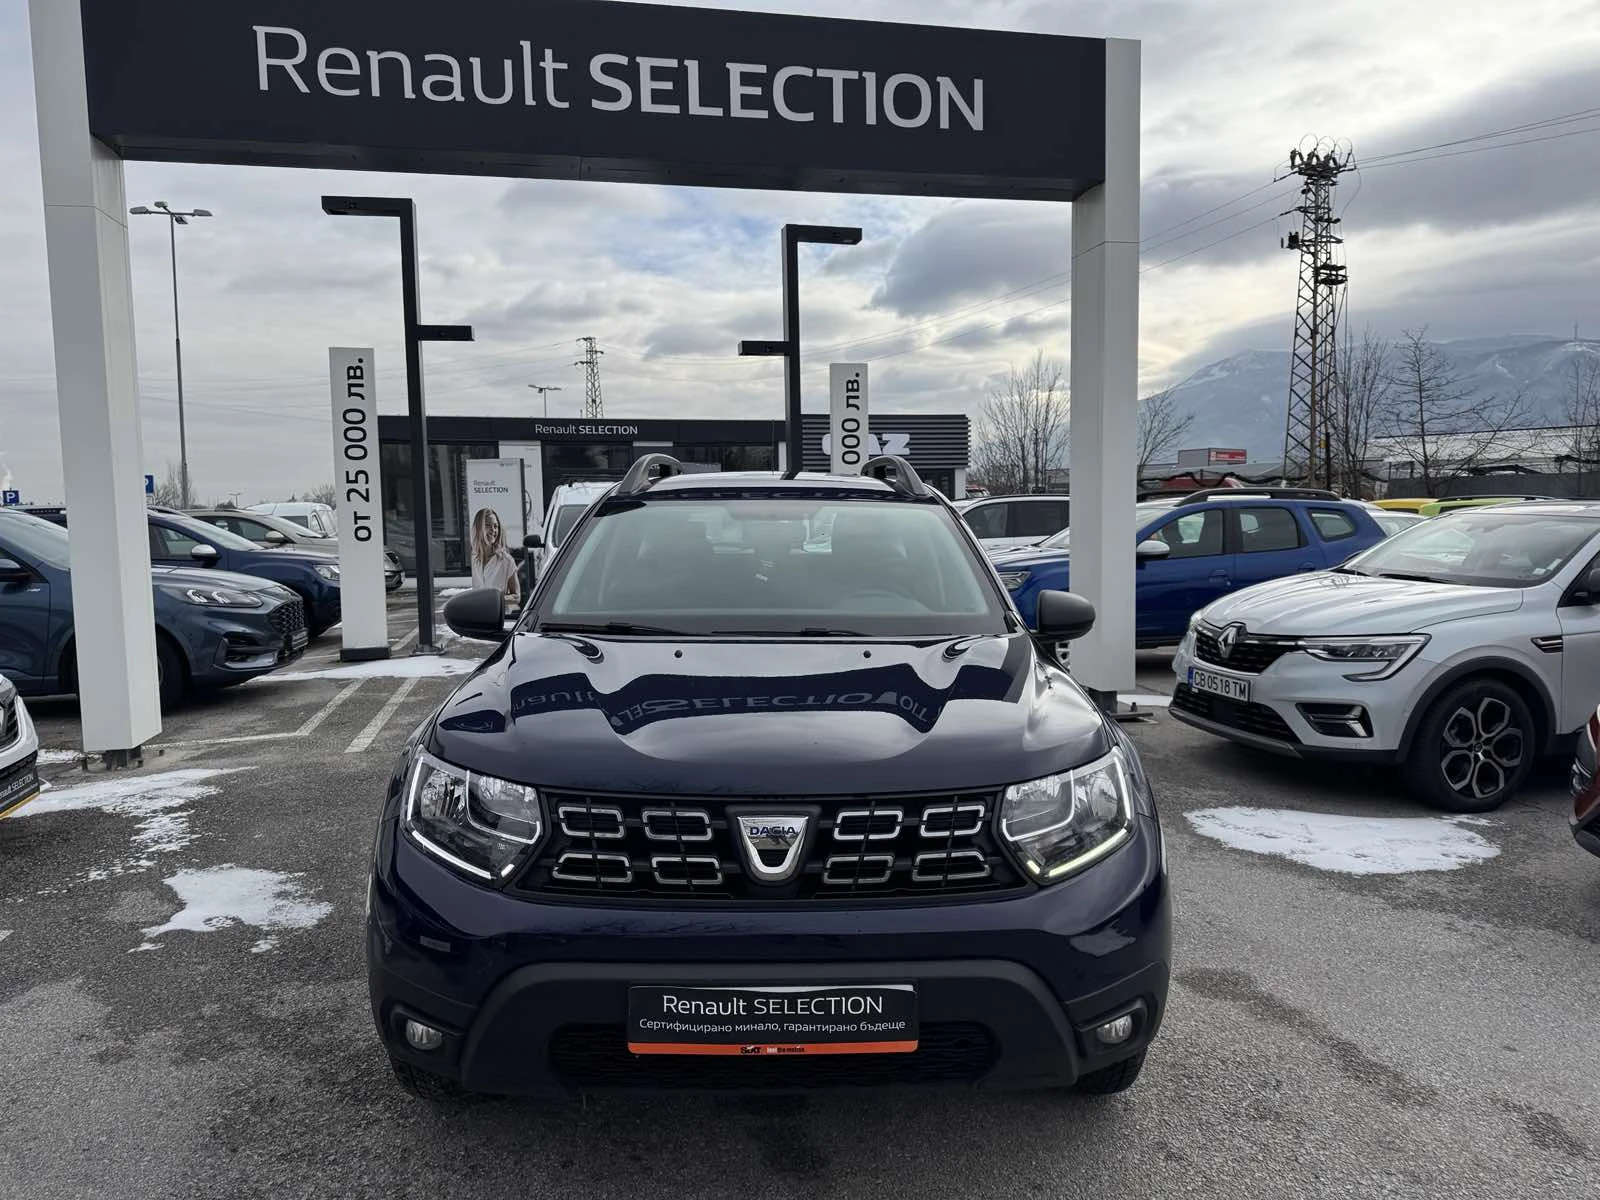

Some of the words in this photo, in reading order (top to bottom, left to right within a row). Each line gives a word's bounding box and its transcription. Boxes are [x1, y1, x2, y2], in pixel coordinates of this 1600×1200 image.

[252, 25, 570, 109] Renault
[590, 53, 984, 132] SELECTION
[346, 357, 366, 401] лв.
[846, 372, 860, 411] лв.
[342, 408, 369, 461] 000
[535, 424, 577, 434] Renault
[578, 425, 638, 435] SELECTION
[841, 418, 861, 465] 000
[6, 492, 15, 503] P
[346, 469, 370, 503] 25
[354, 511, 372, 541] от
[1207, 675, 1231, 694] 0518
[750, 826, 797, 836] DACIA
[662, 995, 748, 1015] Renault
[753, 996, 883, 1015] SELECTION
[639, 1018, 733, 1034] Сертифицирано
[735, 1021, 781, 1033] минало,
[783, 1022, 857, 1034] гарантирано
[860, 1020, 906, 1032] бъдеще
